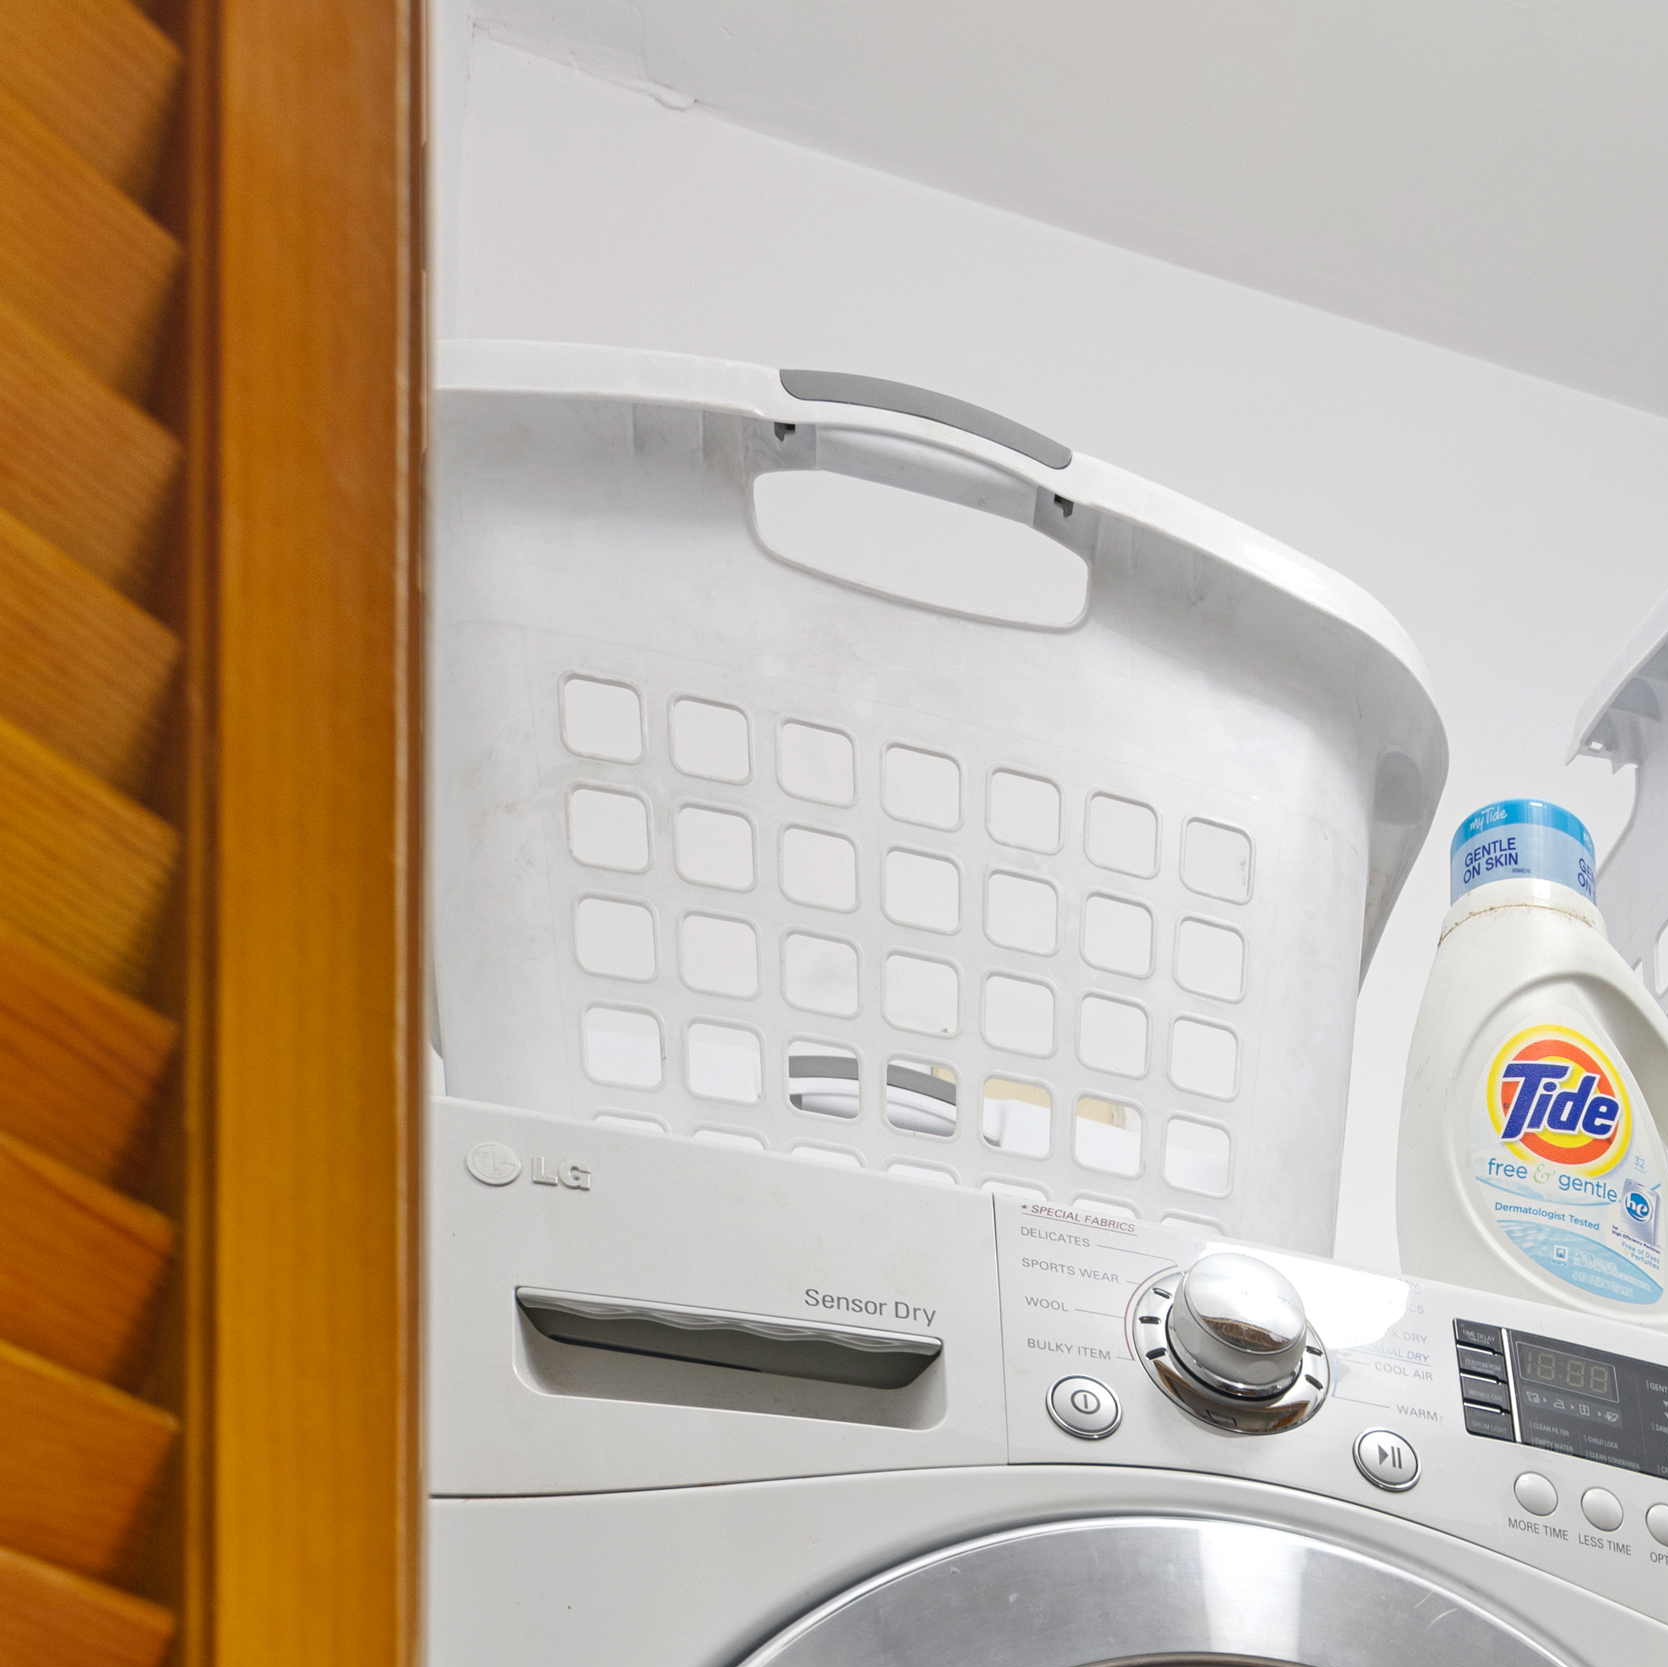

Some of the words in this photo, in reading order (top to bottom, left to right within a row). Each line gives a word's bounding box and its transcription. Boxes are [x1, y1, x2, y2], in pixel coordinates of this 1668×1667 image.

[1465, 837, 1516, 868] GENTLE
[1463, 864, 1481, 884] ON
[1485, 852, 1518, 871] SKIN
[1501, 1063, 1620, 1139] Tide
[532, 1156, 592, 1190] LG
[1488, 1158, 1528, 1179] free
[1533, 1163, 1556, 1184] &
[1558, 1174, 1618, 1202] gentle
[1031, 1205, 1080, 1221] SPECIAL
[1084, 1215, 1136, 1232] FABRICS
[1495, 1201, 1566, 1221] Dermatologist
[1569, 1214, 1600, 1231] Tested
[1020, 1226, 1090, 1248] DELICATES
[1021, 1257, 1075, 1275] SPORTS
[1079, 1267, 1119, 1283] WEAR
[804, 1288, 887, 1317] Sensor
[895, 1301, 937, 1326] Dry
[1025, 1296, 1069, 1312] WOOL
[1027, 1338, 1073, 1354] BULKY
[1078, 1346, 1111, 1360] ITEM
[1375, 1362, 1409, 1377] COOL
[1413, 1370, 1433, 1382] AIR
[1396, 1404, 1438, 1421] WARM
[1508, 1517, 1540, 1534] MORE
[1543, 1525, 1569, 1541] TIME
[1578, 1533, 1604, 1549] LESS
[1607, 1539, 1632, 1556] TIME
